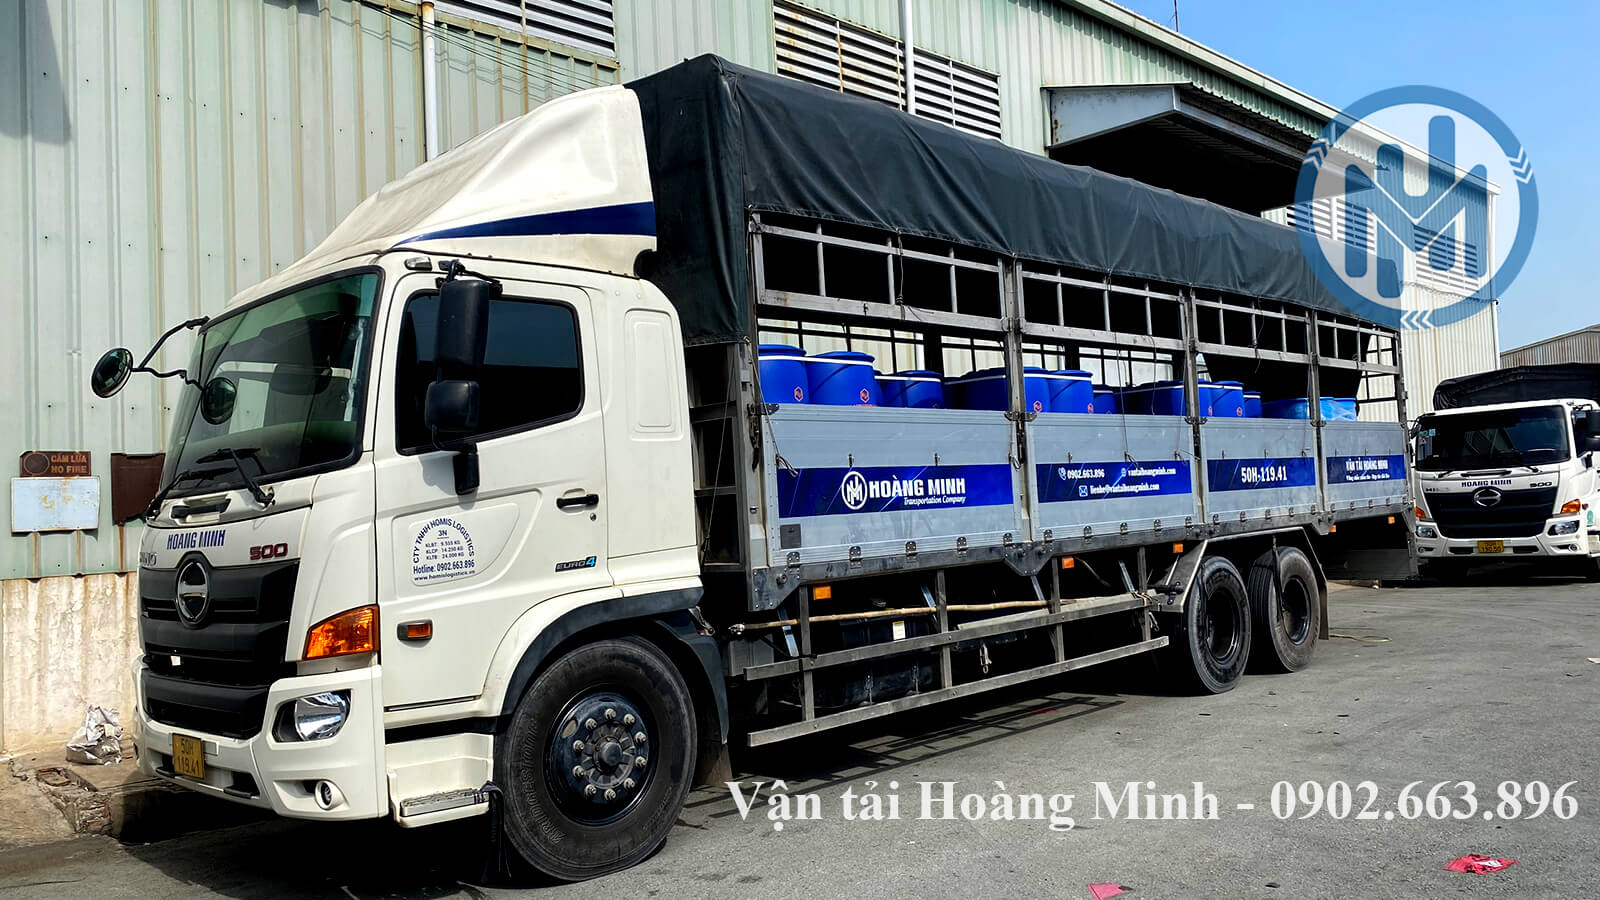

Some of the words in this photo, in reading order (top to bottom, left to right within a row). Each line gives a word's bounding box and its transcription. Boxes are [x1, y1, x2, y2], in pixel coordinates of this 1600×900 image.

[66, 465, 87, 473] FIRE
[1067, 468, 1105, 479] 0902.663.896
[1241, 465, 1288, 483] 50H-119.41
[869, 474, 924, 499] HOÀNG
[927, 477, 966, 496] MINH
[903, 496, 941, 507] Transportation
[942, 495, 966, 505] Company
[167, 532, 197, 550] HOANG
[198, 530, 226, 548] MINH
[415, 524, 431, 545] TNHH
[430, 517, 453, 528] HOMIS
[453, 520, 475, 557] LOGISTICS
[250, 542, 288, 561] 500
[413, 565, 436, 574] Hotline:
[436, 559, 475, 572] 0902.663.896
